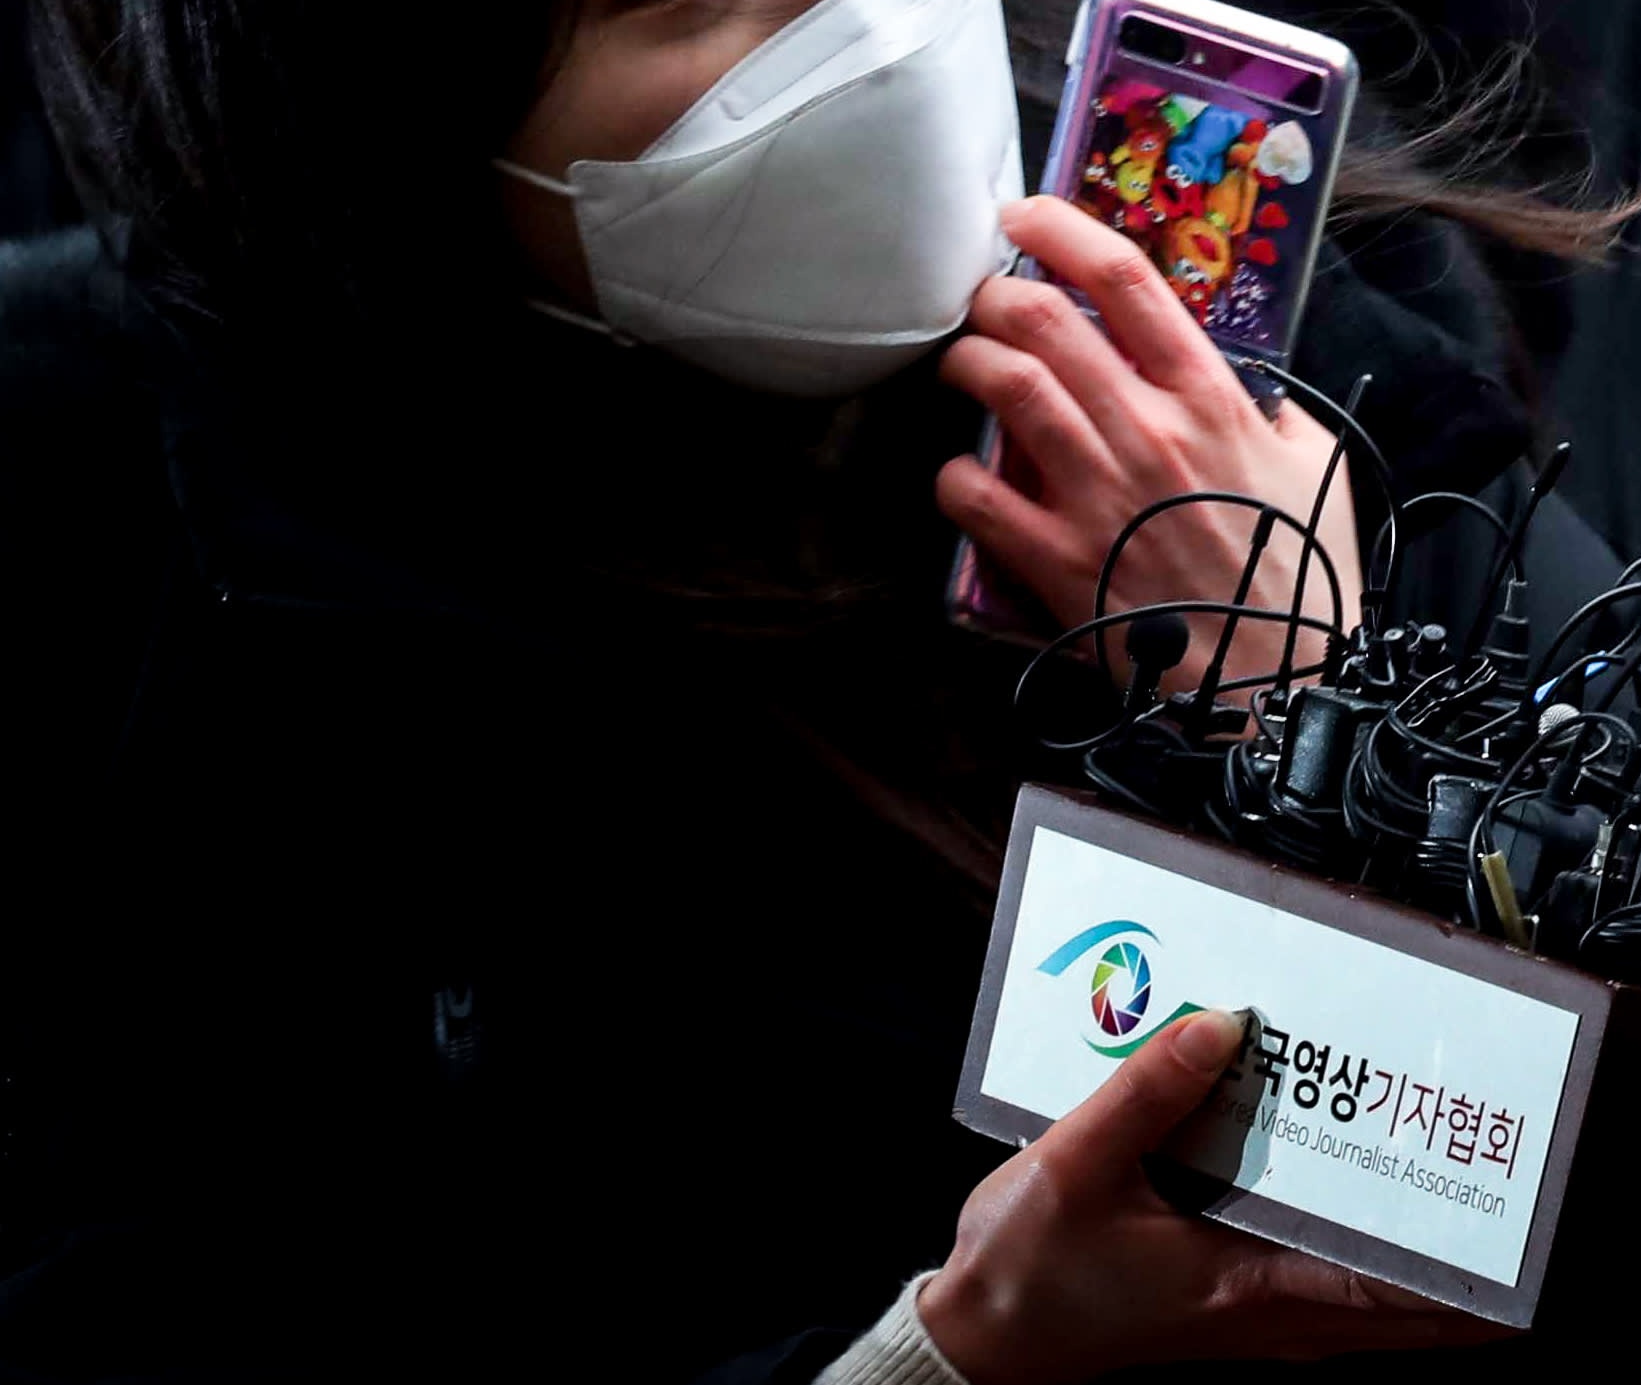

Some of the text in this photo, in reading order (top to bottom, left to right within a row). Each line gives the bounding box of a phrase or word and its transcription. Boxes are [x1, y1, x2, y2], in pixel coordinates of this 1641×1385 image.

[1259, 1106, 1309, 1146] Video
[1310, 1126, 1400, 1179] Journalist
[1401, 1159, 1506, 1218] Association
